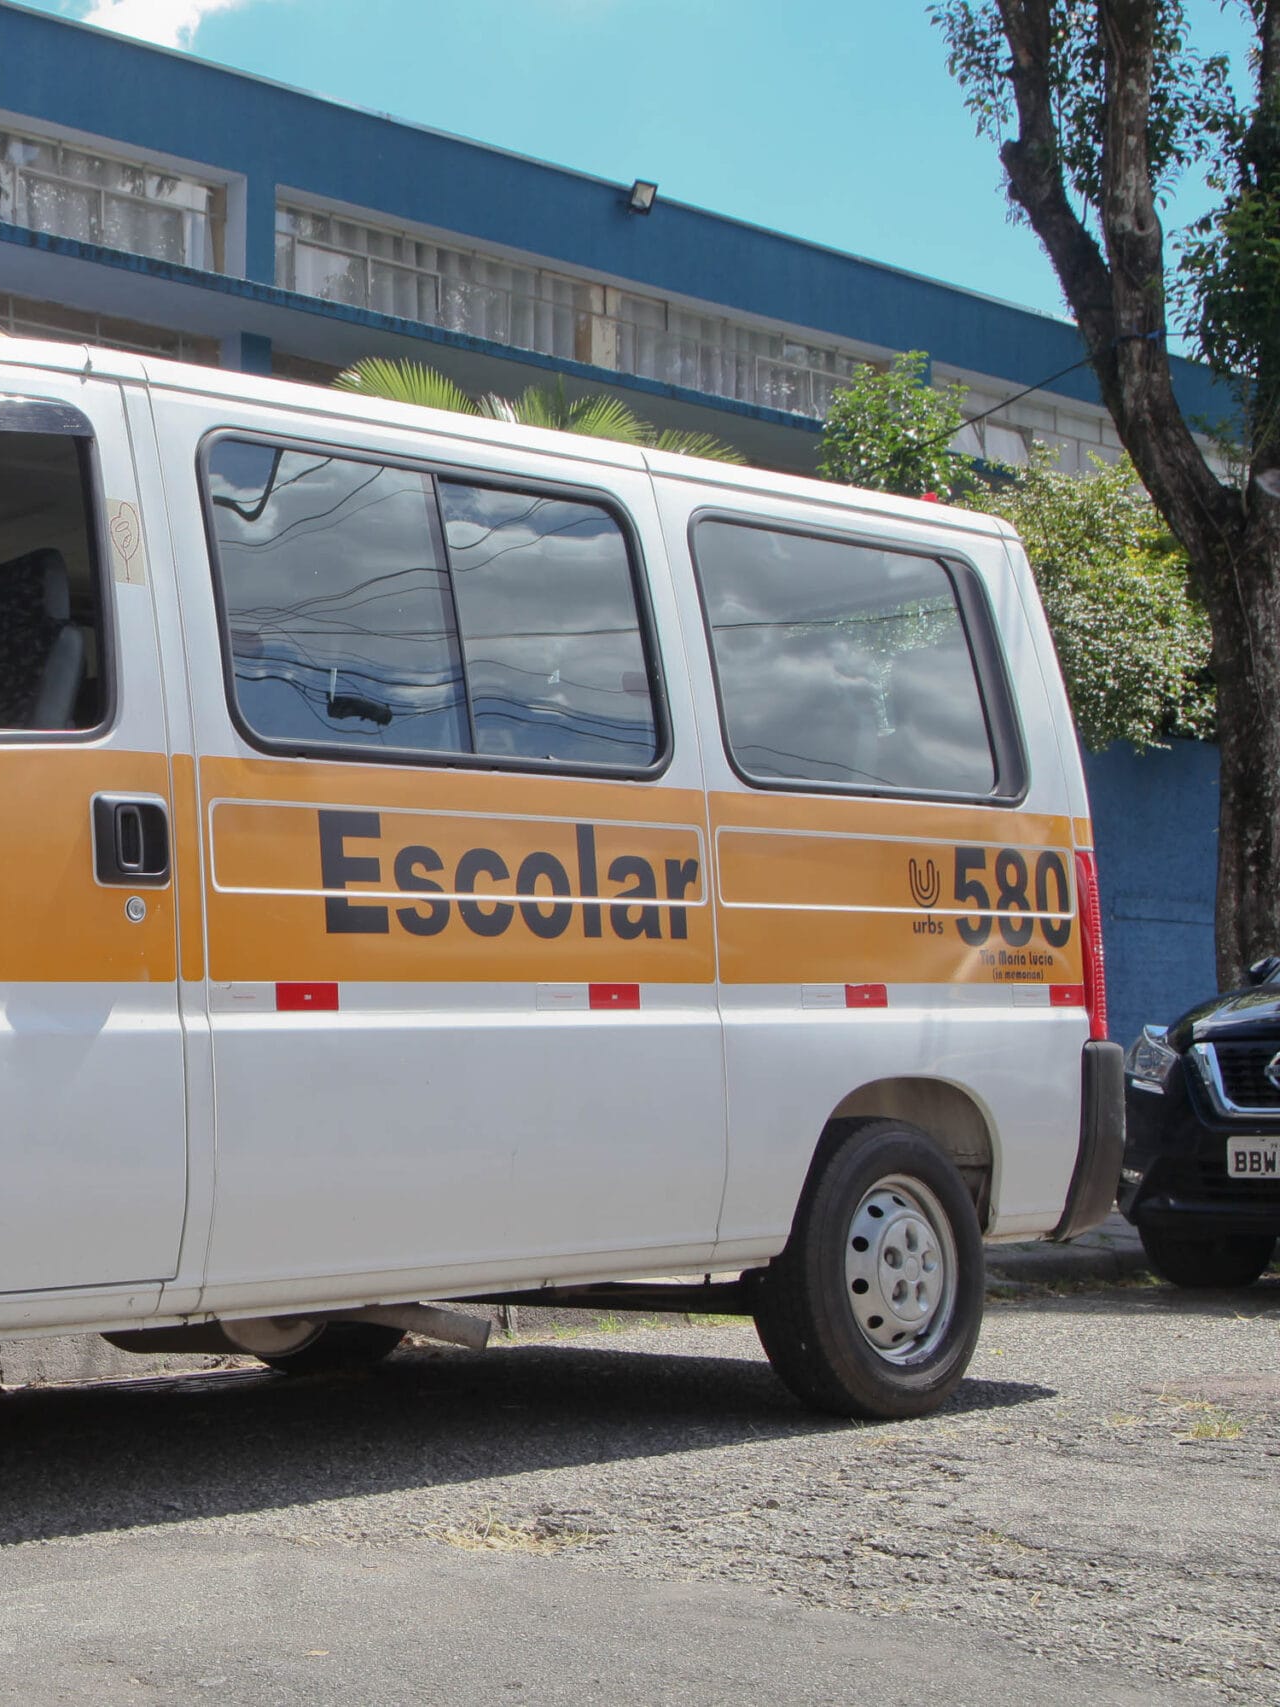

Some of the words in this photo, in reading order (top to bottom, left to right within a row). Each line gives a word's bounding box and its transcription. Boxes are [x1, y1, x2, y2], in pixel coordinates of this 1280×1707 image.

[319, 809, 698, 939] Escolar
[955, 847, 1072, 947] 580
[913, 913, 944, 934] urbs
[999, 949, 1026, 966] Maria
[1234, 1151, 1276, 1172] BBW
